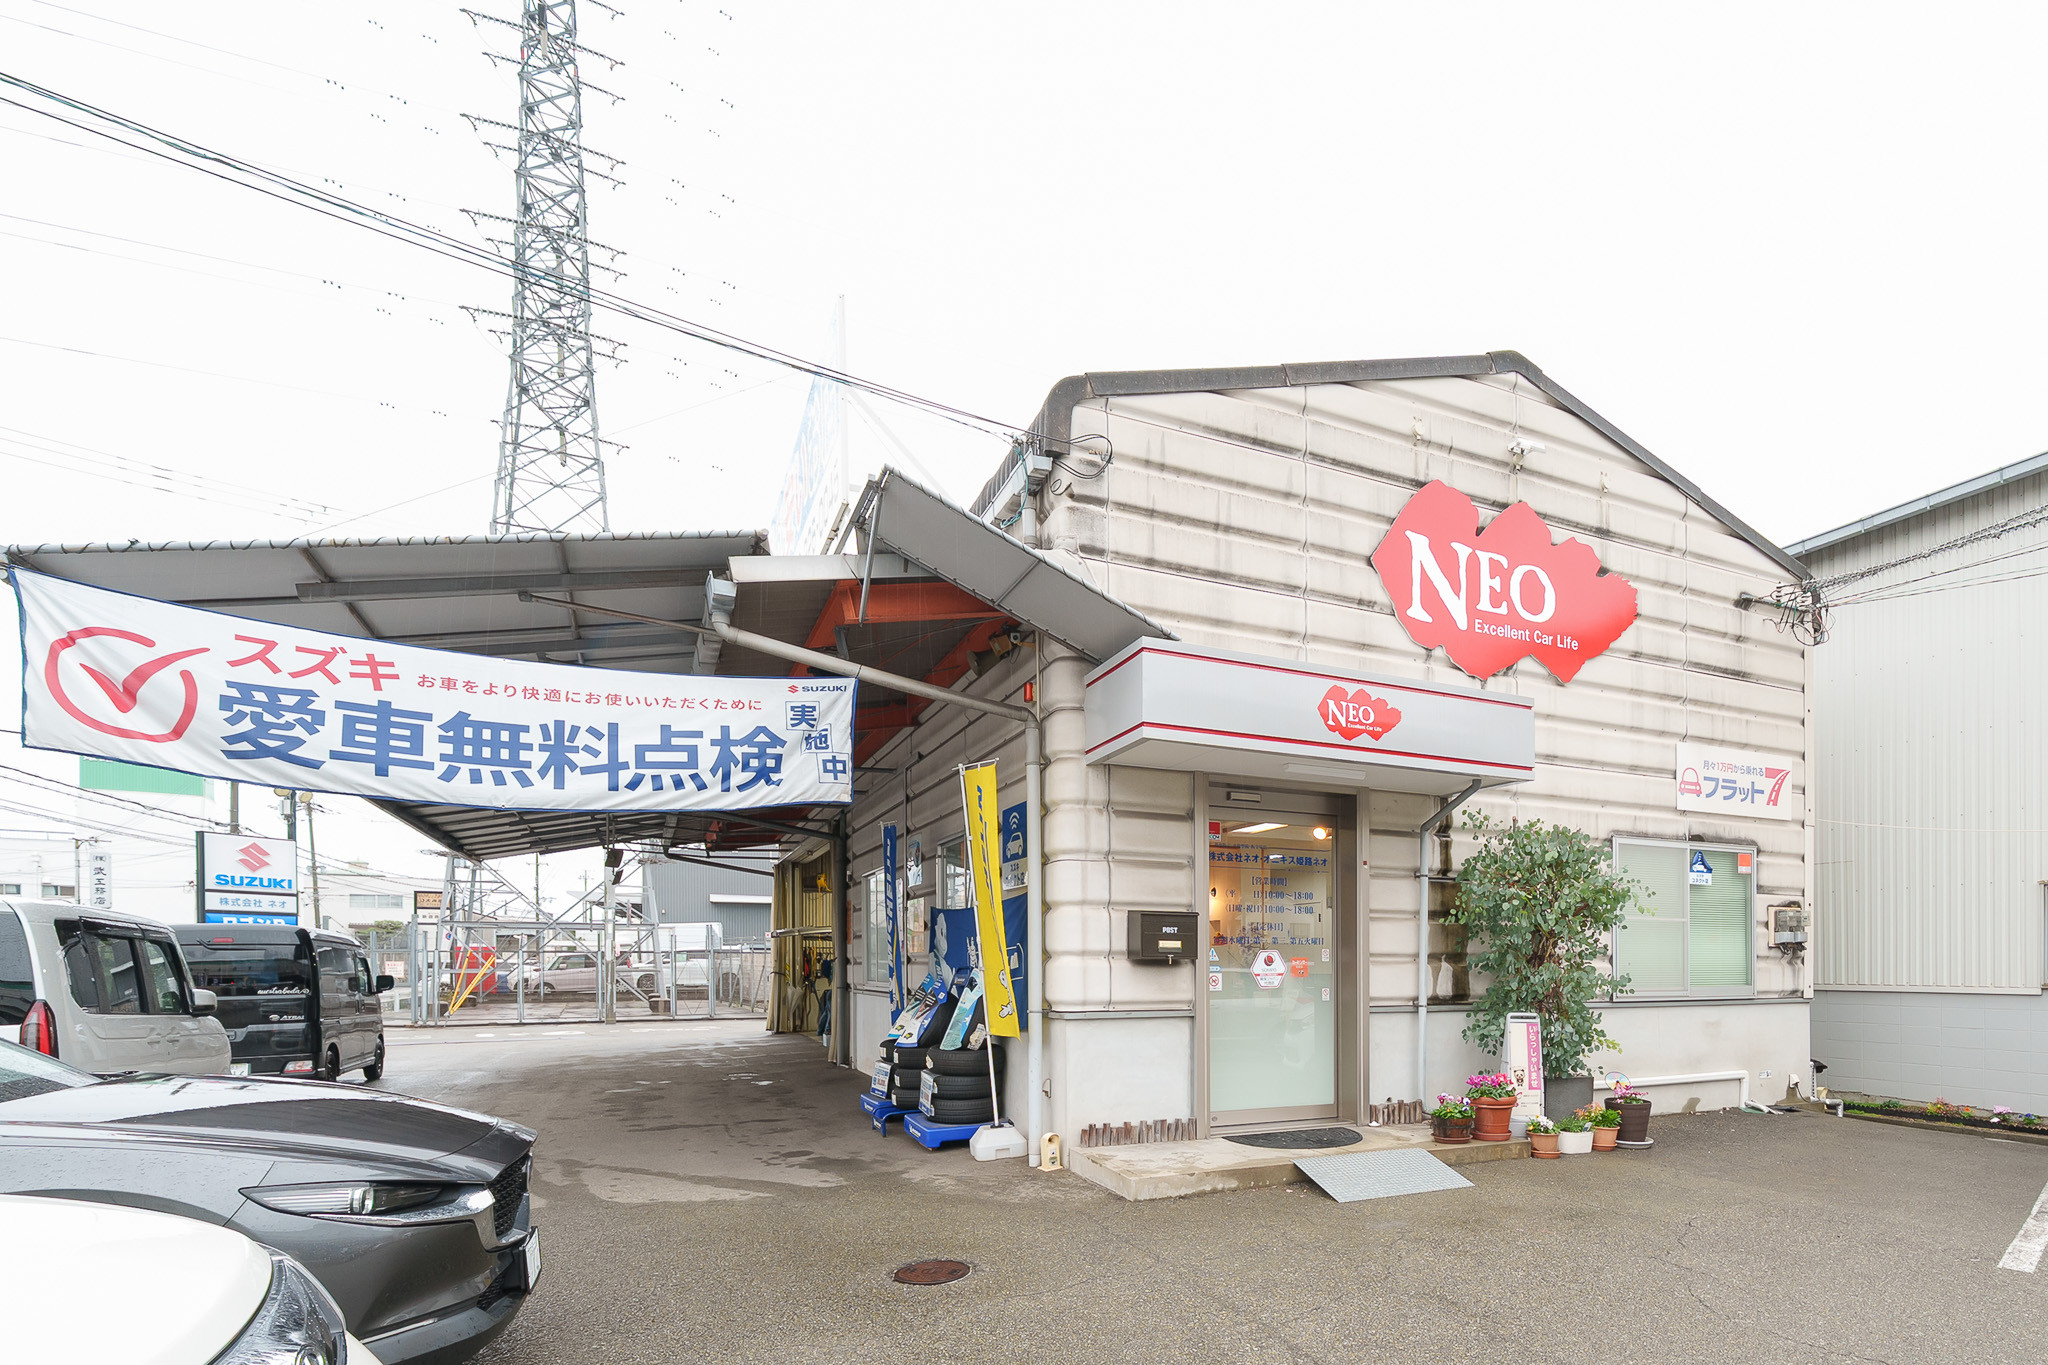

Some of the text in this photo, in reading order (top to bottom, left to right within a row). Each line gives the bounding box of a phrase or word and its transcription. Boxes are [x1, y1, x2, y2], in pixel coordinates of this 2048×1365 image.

[1405, 530, 1556, 631] NEO
[1474, 618, 1579, 650] Excellent Car Life
[226, 634, 400, 691] スズキ
[417, 674, 763, 711] お車をより快適にお使いいただくために
[1326, 699, 1375, 728] NEO
[219, 680, 788, 793] 愛車無料点検
[1703, 760, 1764, 777] 月々1万円から乗れる
[215, 874, 292, 889] SUZUKI
[219, 897, 287, 909] 株式会社 ネオ
[1162, 926, 1178, 934] POST
[1528, 1025, 1539, 1088] いらっしゃいませ
